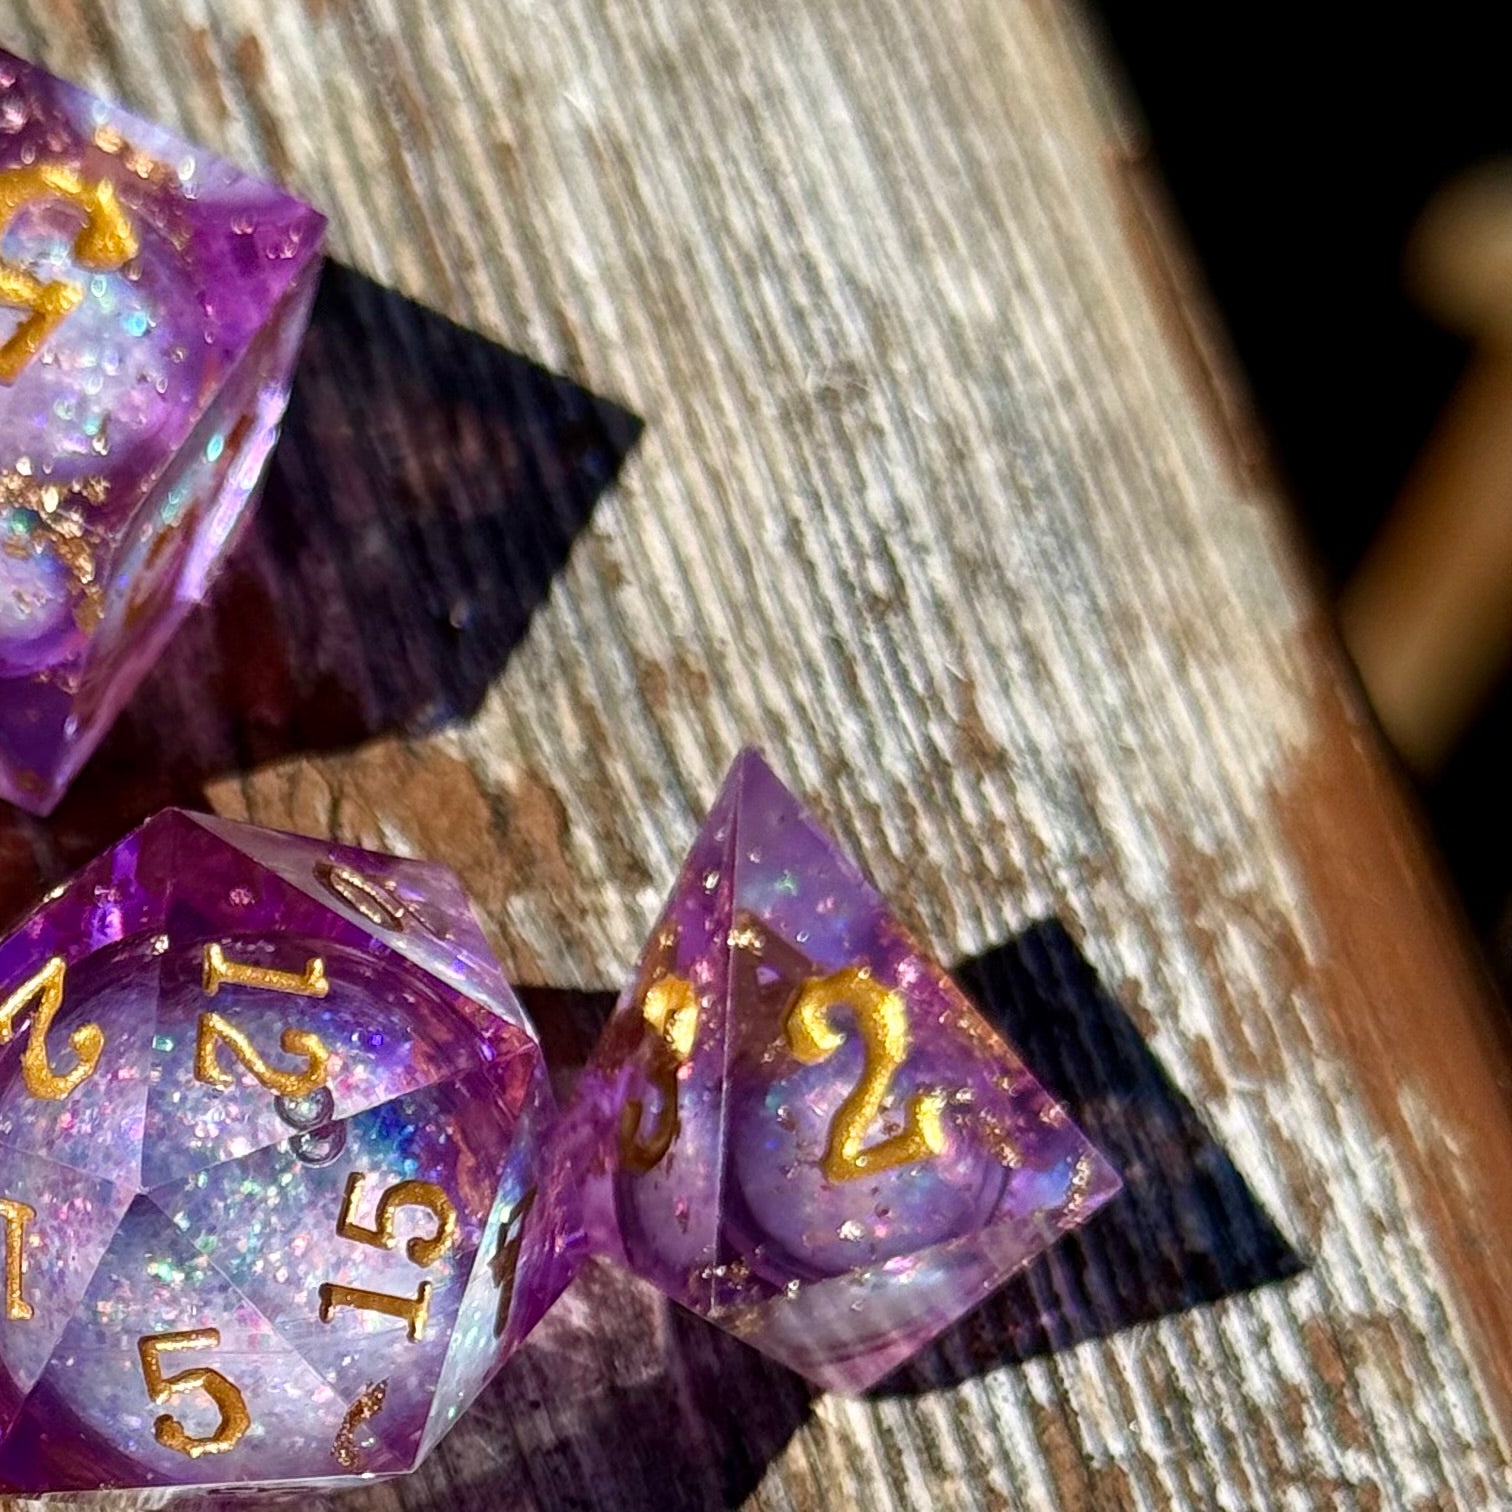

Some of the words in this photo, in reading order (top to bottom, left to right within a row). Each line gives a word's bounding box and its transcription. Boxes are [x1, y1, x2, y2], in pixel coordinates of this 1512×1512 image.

[193, 942, 329, 1099] 12
[786, 965, 946, 1185] 2
[318, 1171, 458, 1344] 15
[137, 1327, 252, 1459] 5
